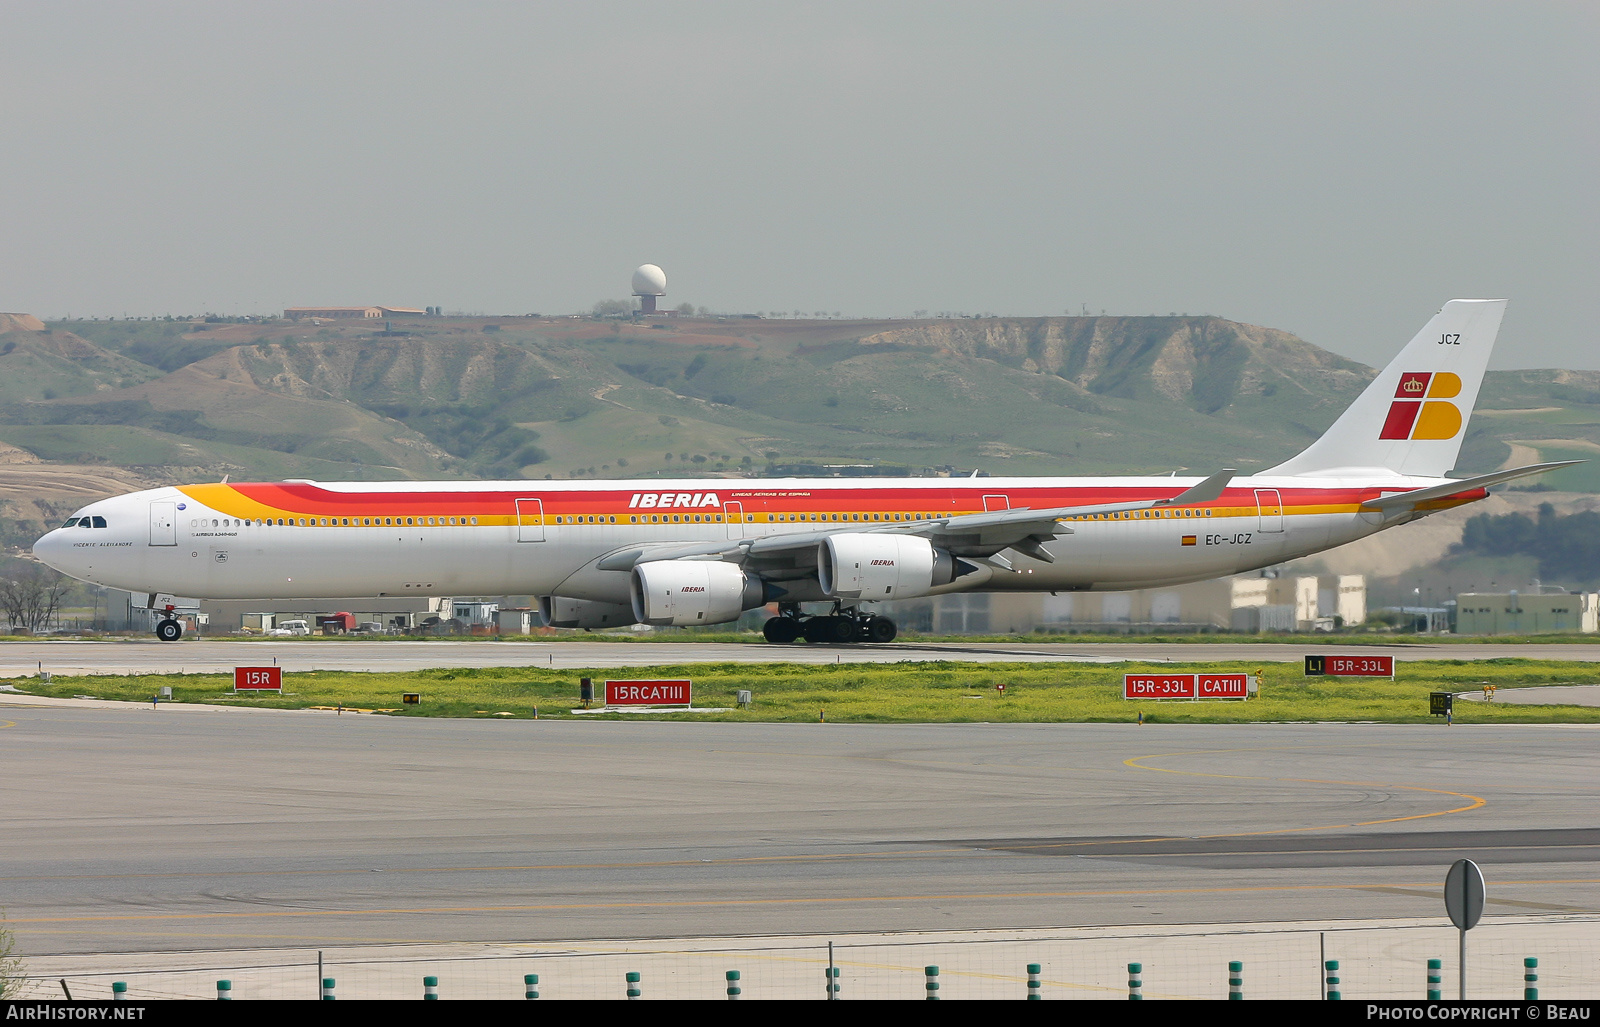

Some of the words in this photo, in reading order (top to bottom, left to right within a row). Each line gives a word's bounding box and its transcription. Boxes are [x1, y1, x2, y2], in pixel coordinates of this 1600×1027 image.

[1437, 333, 1461, 346] JCZ
[628, 492, 721, 508] IBERIA
[1205, 533, 1252, 546] EC-JCZ
[1309, 660, 1322, 671] L1
[1333, 660, 1385, 672] 15R-33L
[246, 672, 270, 685] 15R
[1132, 680, 1188, 693] 15R-33L
[1203, 679, 1241, 692] CATIII
[614, 685, 683, 700] 15RCATIII
